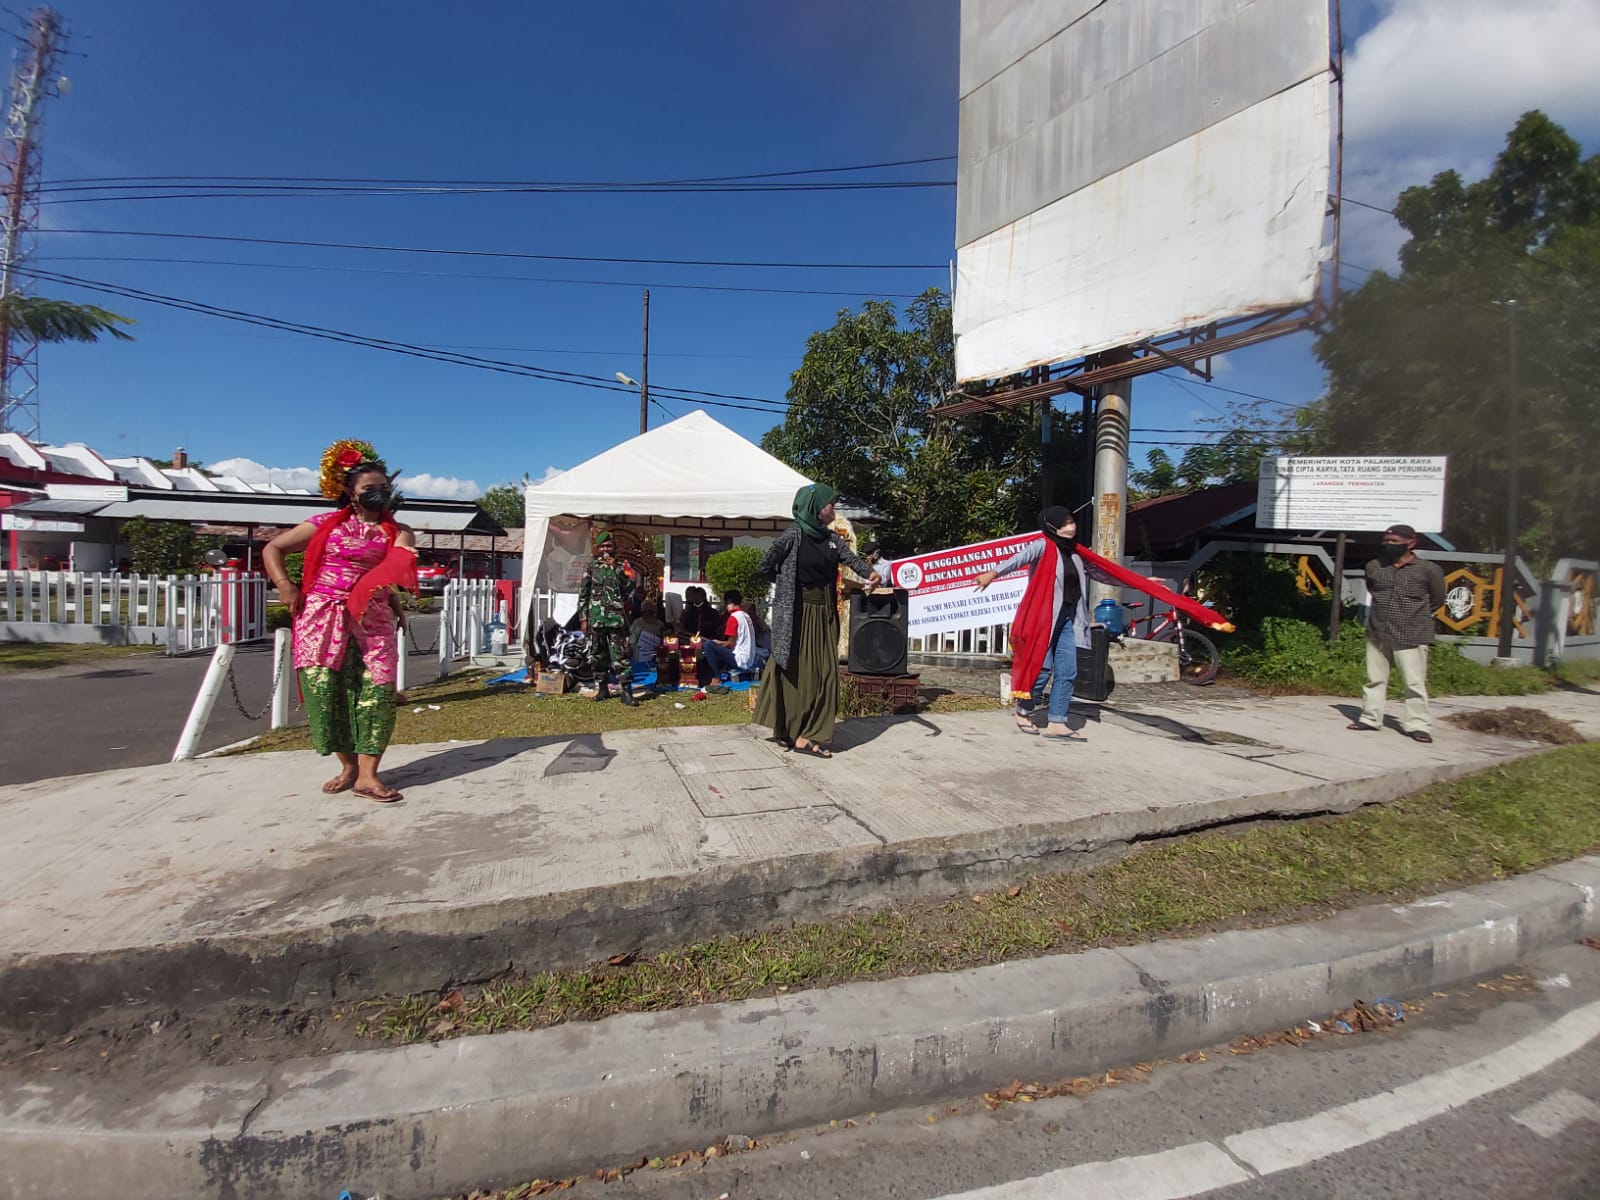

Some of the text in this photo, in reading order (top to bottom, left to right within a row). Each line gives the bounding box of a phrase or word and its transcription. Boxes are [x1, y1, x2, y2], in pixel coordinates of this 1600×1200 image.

[923, 549, 993, 570] PENGGALANGAN
[925, 569, 963, 584] BENCANA
[943, 600, 968, 610] MENARI
[969, 595, 990, 606] UNTUK
[947, 612, 970, 621] SEDIKIT
[992, 604, 1012, 614] UNTUK
